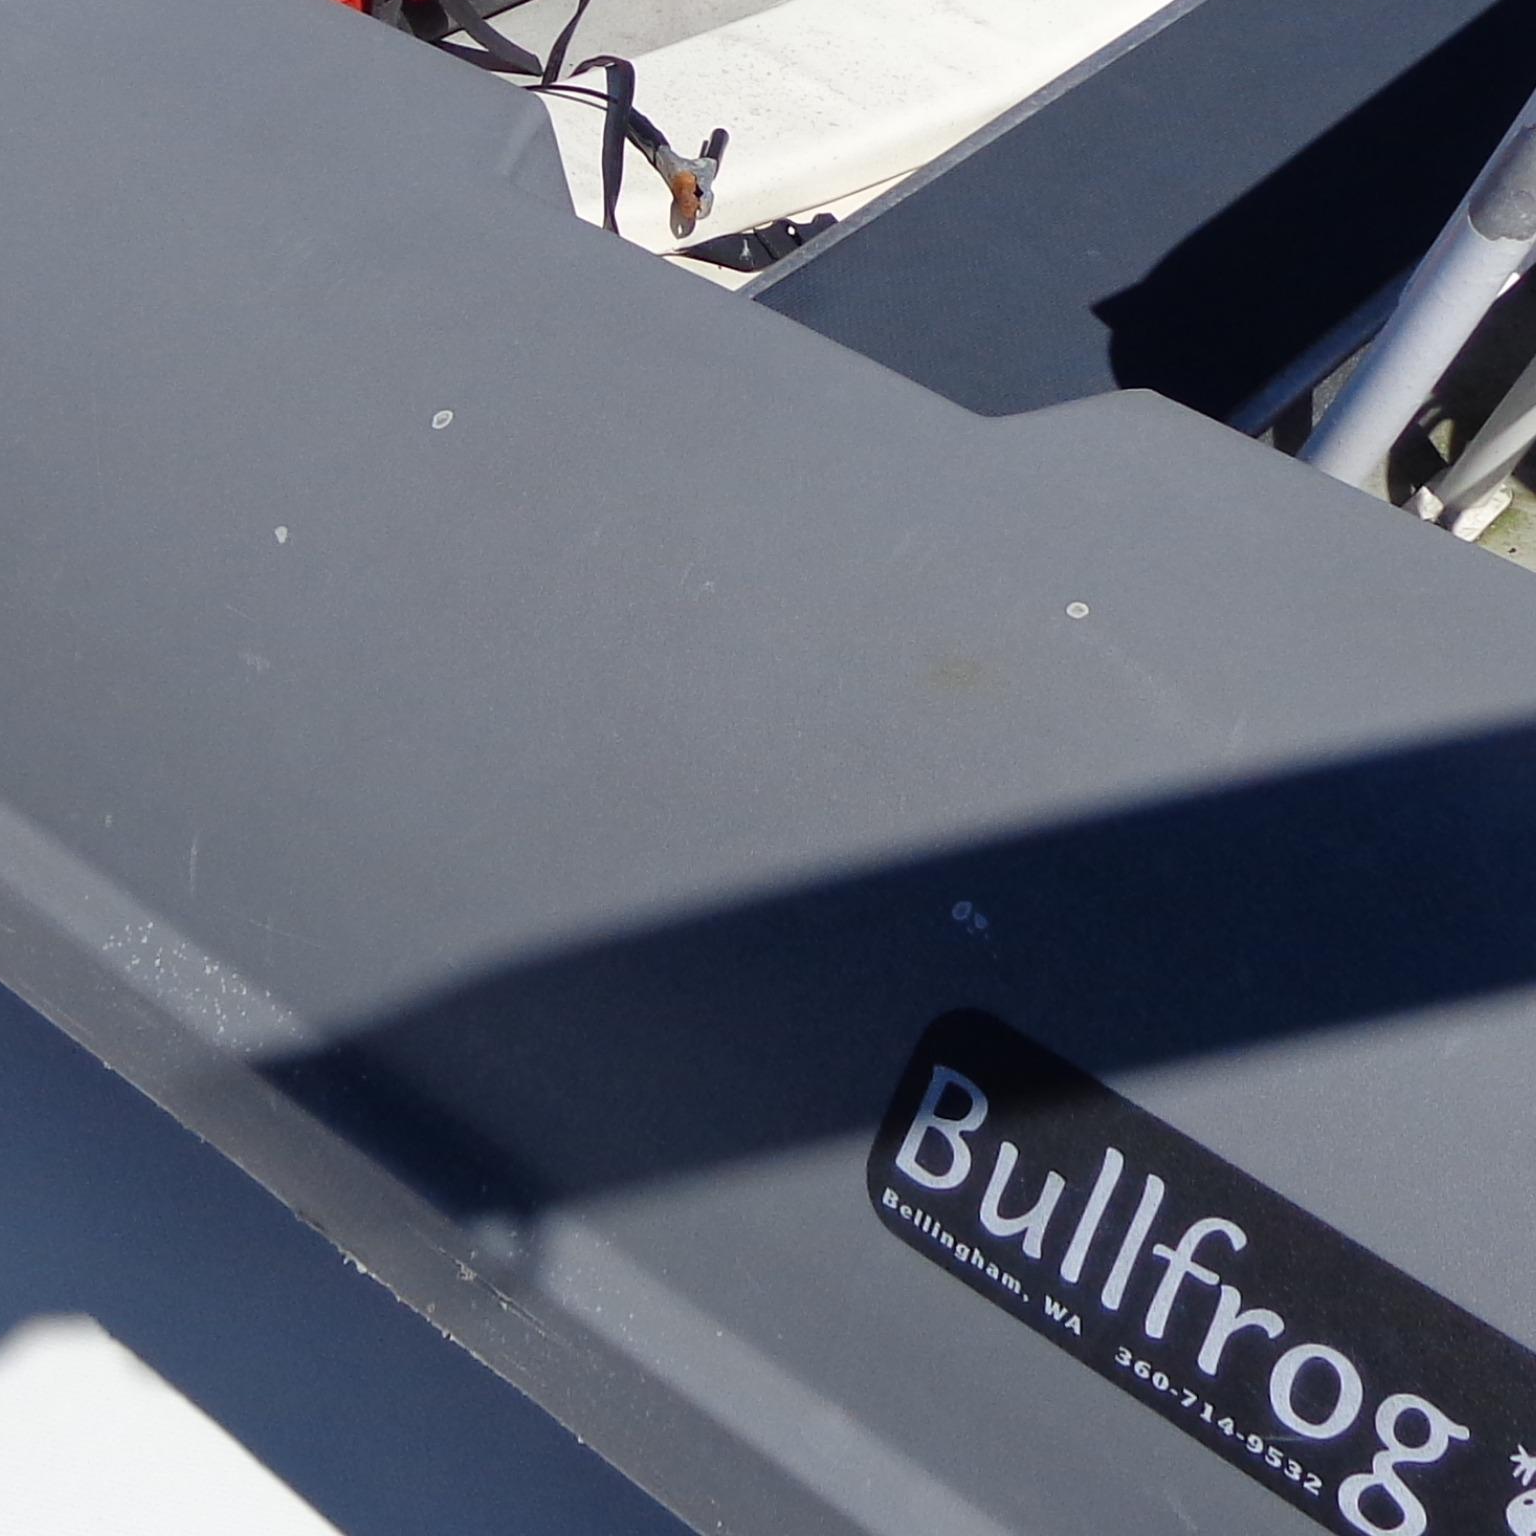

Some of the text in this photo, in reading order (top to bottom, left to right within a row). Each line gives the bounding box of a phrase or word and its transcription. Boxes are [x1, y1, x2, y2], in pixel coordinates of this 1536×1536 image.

[881, 1187, 1323, 1496] Bellingham, WA 360-714-9532
[895, 1065, 1470, 1536] Bullfrog
